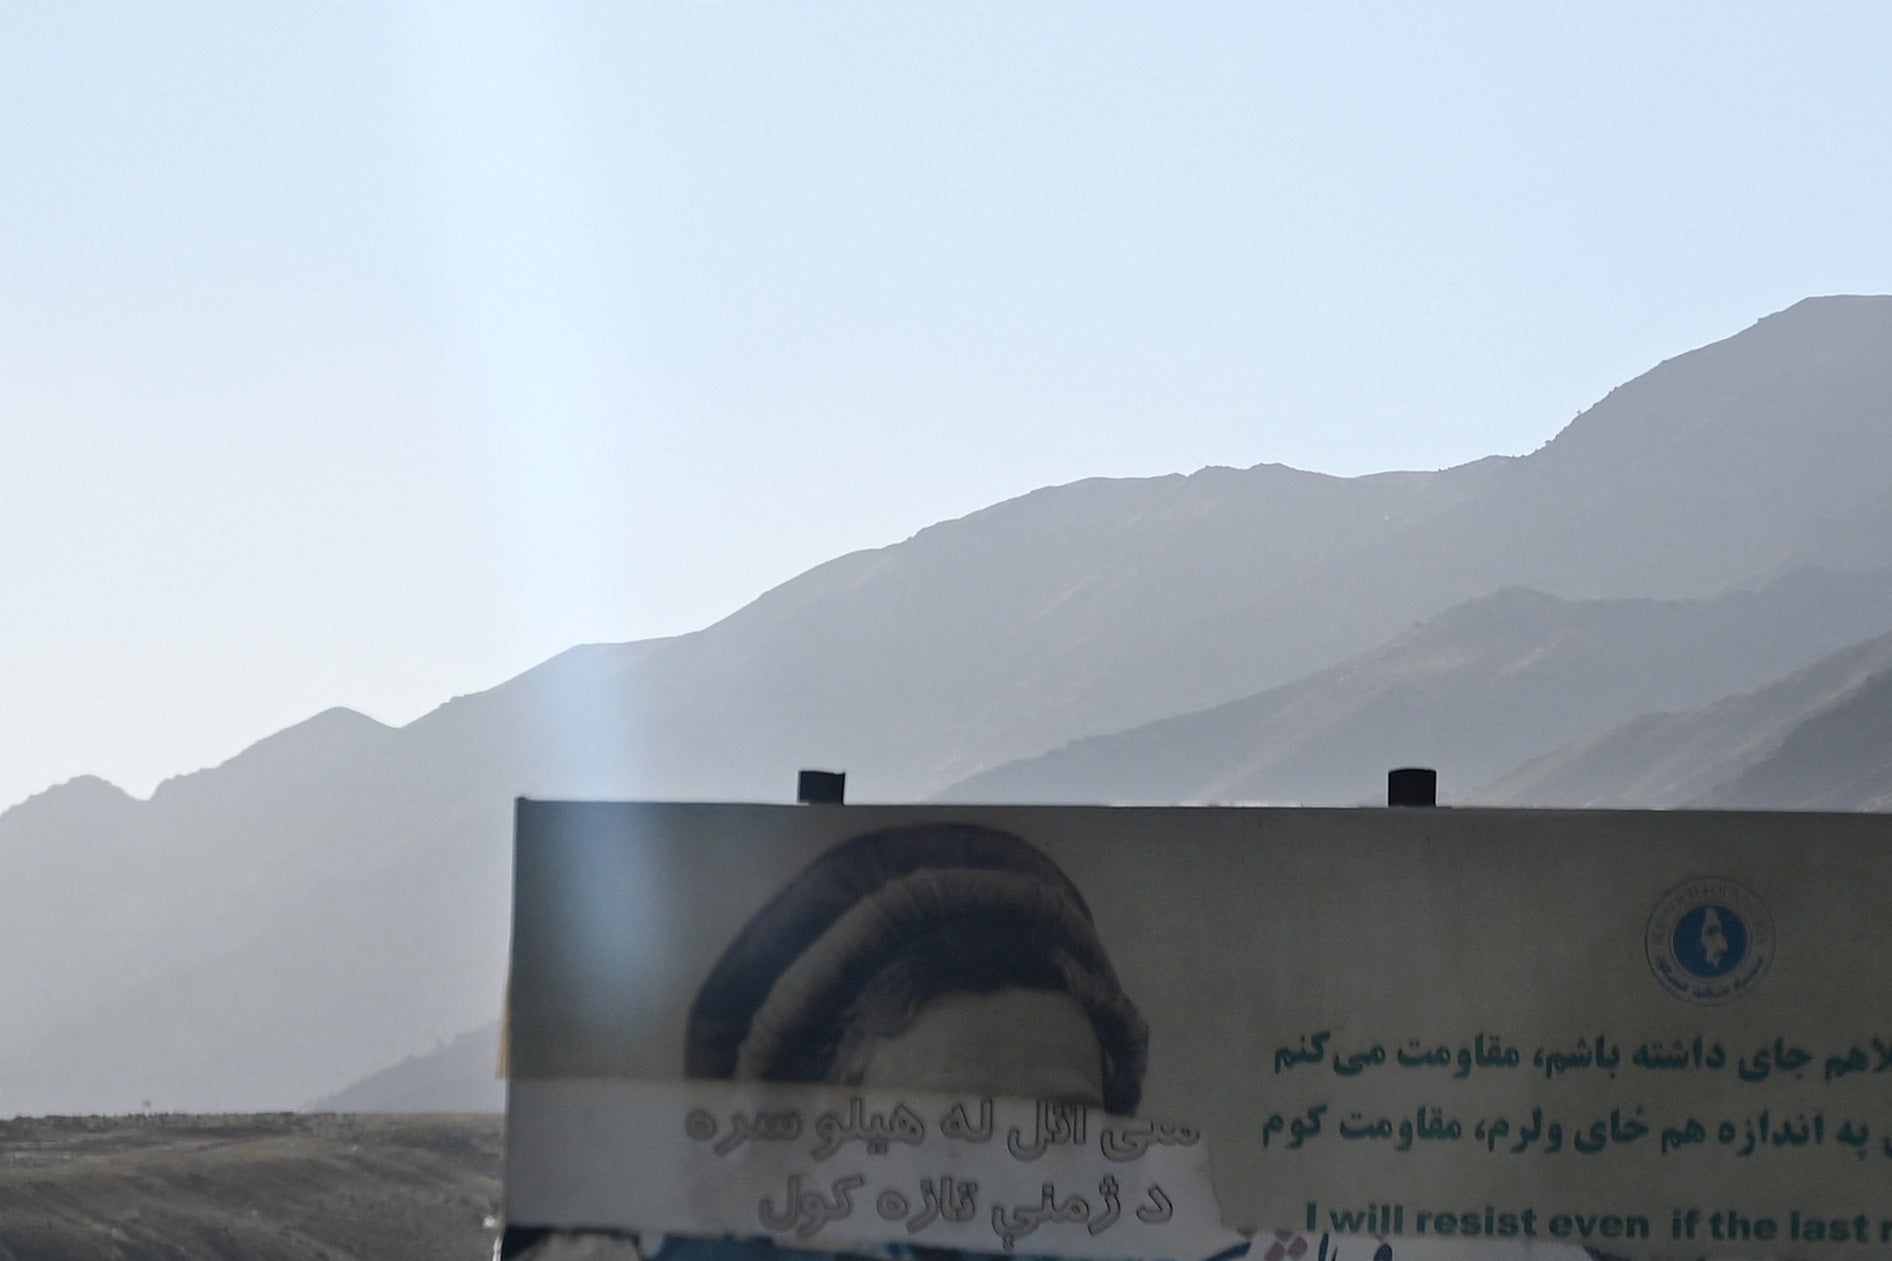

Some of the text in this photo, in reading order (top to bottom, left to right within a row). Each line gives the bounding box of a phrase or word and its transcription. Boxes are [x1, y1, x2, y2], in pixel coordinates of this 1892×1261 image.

[1396, 1032, 1521, 1080] مقاومت
[1533, 1032, 1621, 1080] باشم،
[1632, 1035, 1727, 1072] داشته
[1737, 1037, 1813, 1083] جای
[684, 1108, 804, 1158] سره
[940, 1098, 995, 1143] له
[1261, 1102, 1329, 1150] کوم
[1338, 1105, 1463, 1154] مقاومت
[1660, 1118, 1707, 1156] هم
[1717, 1110, 1825, 1158] اندازه
[757, 1174, 867, 1242] کول
[876, 1175, 981, 1235] تازه
[1135, 1182, 1174, 1225] د
[1305, 1200, 1317, 1233] I
[1328, 1202, 1405, 1238] will
[1415, 1204, 1538, 1241] resist
[1547, 1213, 1651, 1240] even
[1671, 1208, 1701, 1241] if
[1708, 1209, 1779, 1243] the
[1789, 1210, 1870, 1244] last
